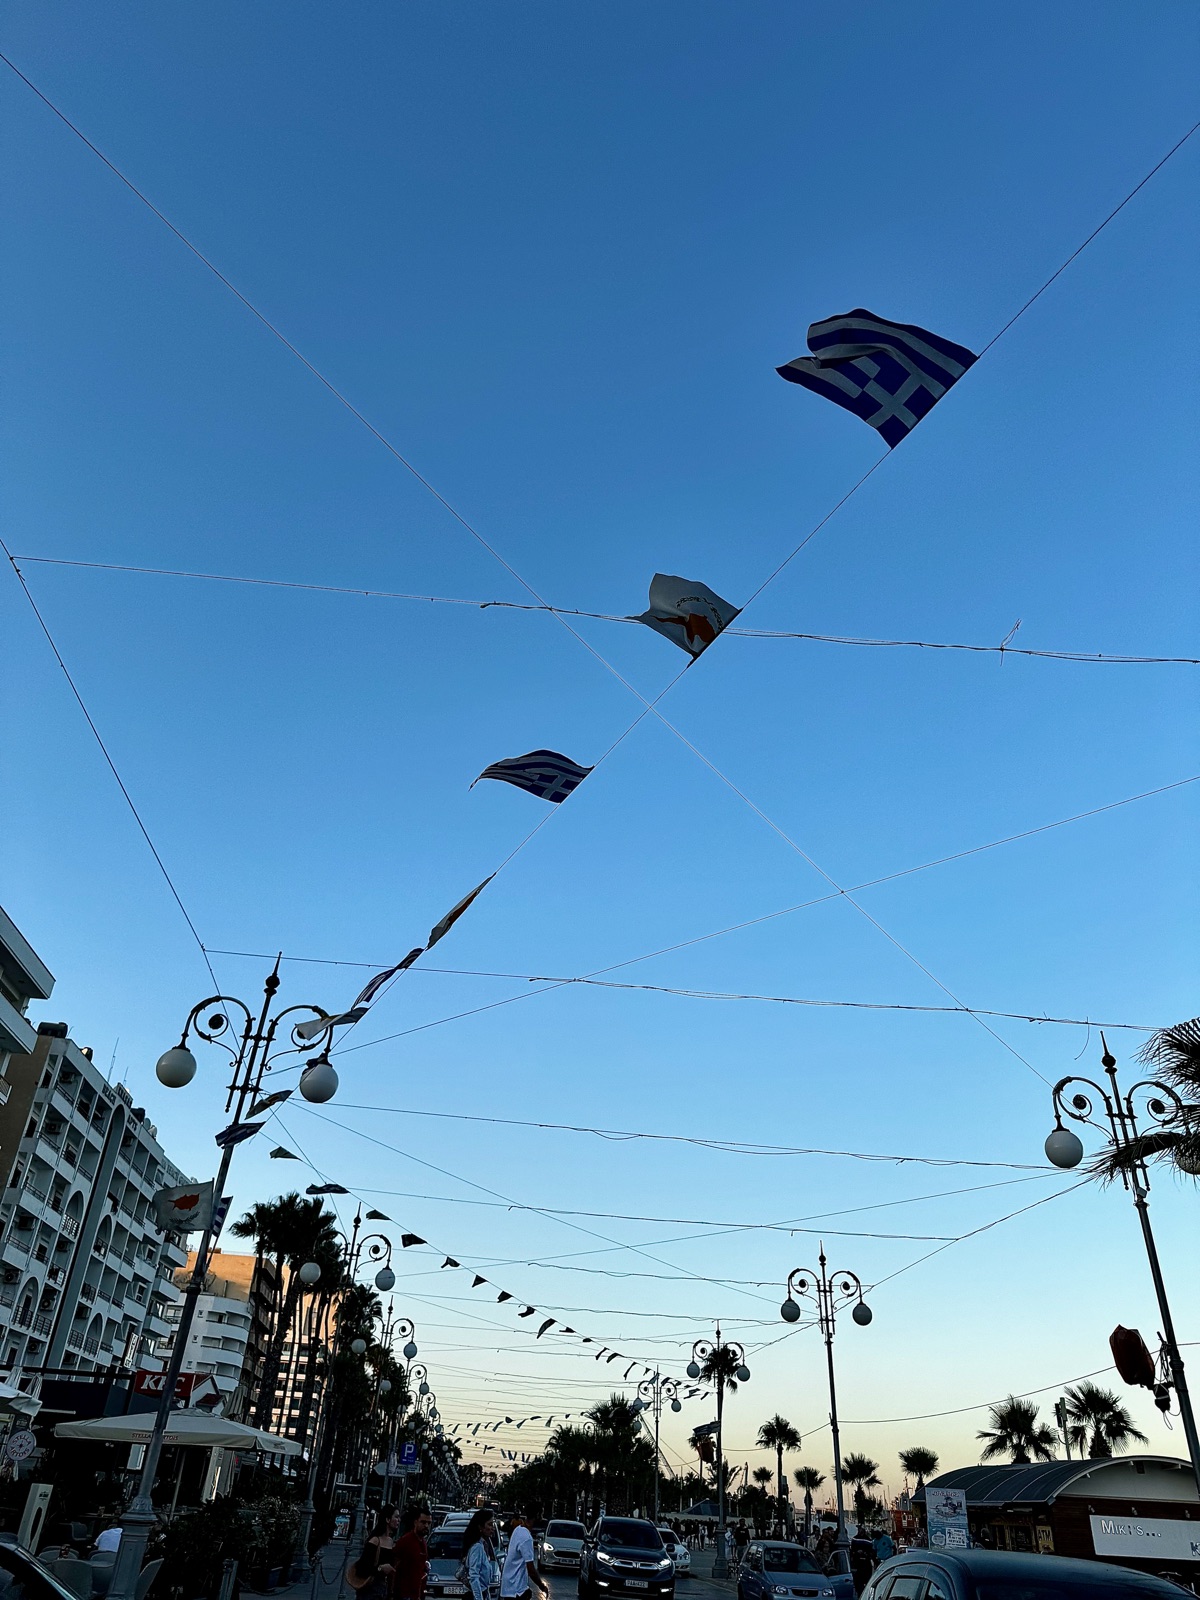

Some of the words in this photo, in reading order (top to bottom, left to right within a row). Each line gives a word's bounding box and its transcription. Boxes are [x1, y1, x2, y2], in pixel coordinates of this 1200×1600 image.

[12, 1434, 32, 1446] STELLA
[10, 1446, 30, 1458] ARTOIS
[404, 1444, 415, 1457] P
[1038, 1529, 1052, 1542] ATM
